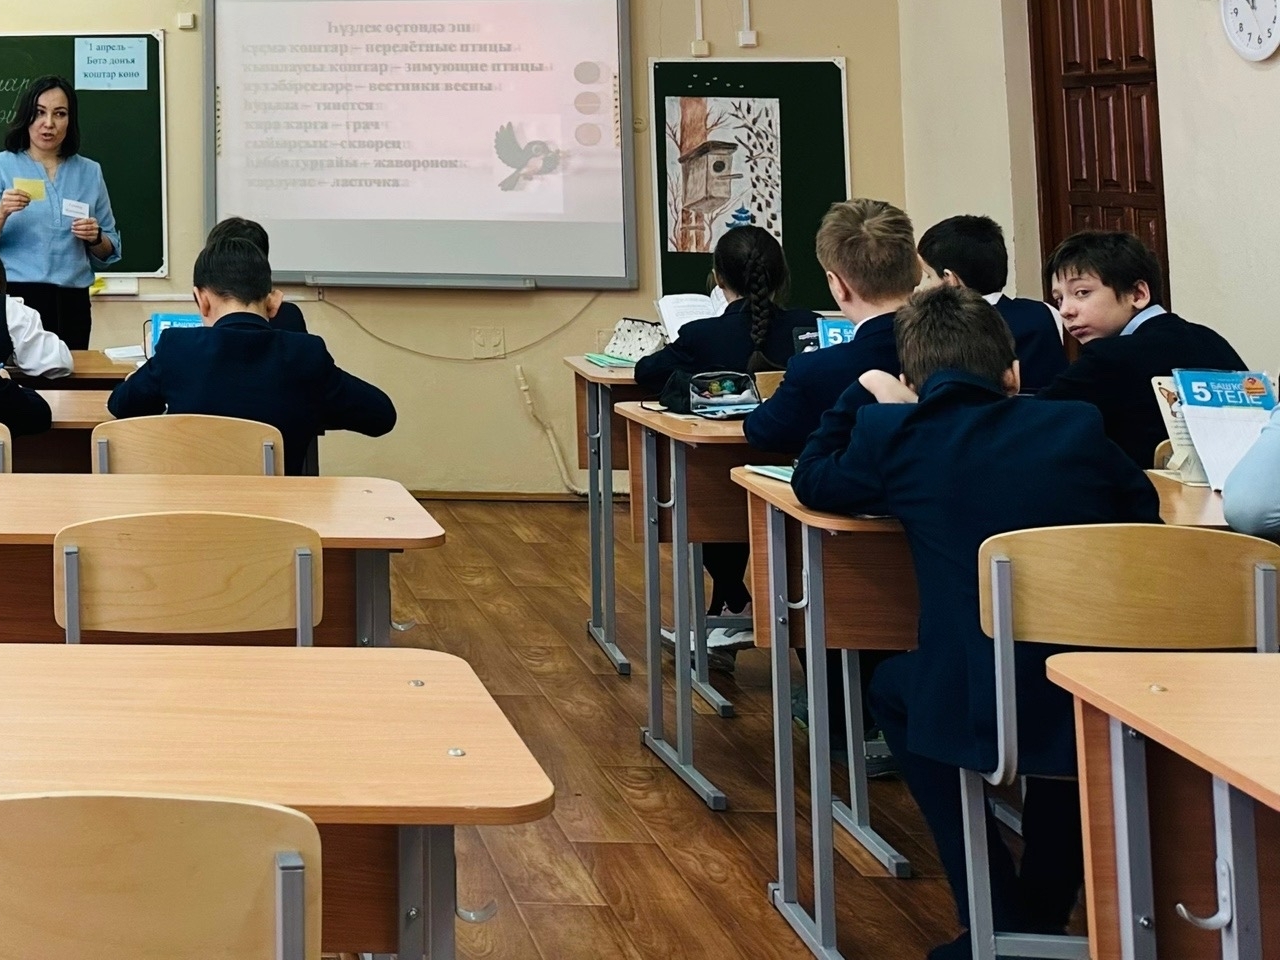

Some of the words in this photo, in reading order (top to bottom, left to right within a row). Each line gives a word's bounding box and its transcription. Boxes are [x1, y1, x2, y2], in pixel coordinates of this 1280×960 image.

[96, 44, 126, 53] апрель
[365, 41, 457, 55] перелётные
[460, 43, 512, 53] птицы
[405, 62, 488, 75] зимующие
[491, 62, 545, 73] птицы
[369, 82, 440, 91] вестники
[444, 82, 493, 91] весны
[346, 120, 380, 133] грач
[374, 158, 459, 171] жаворонок
[331, 178, 400, 188] ласточка
[828, 327, 843, 344] 5
[1191, 381, 1212, 402] 5
[1212, 390, 1262, 405] ТЕЛЕ
